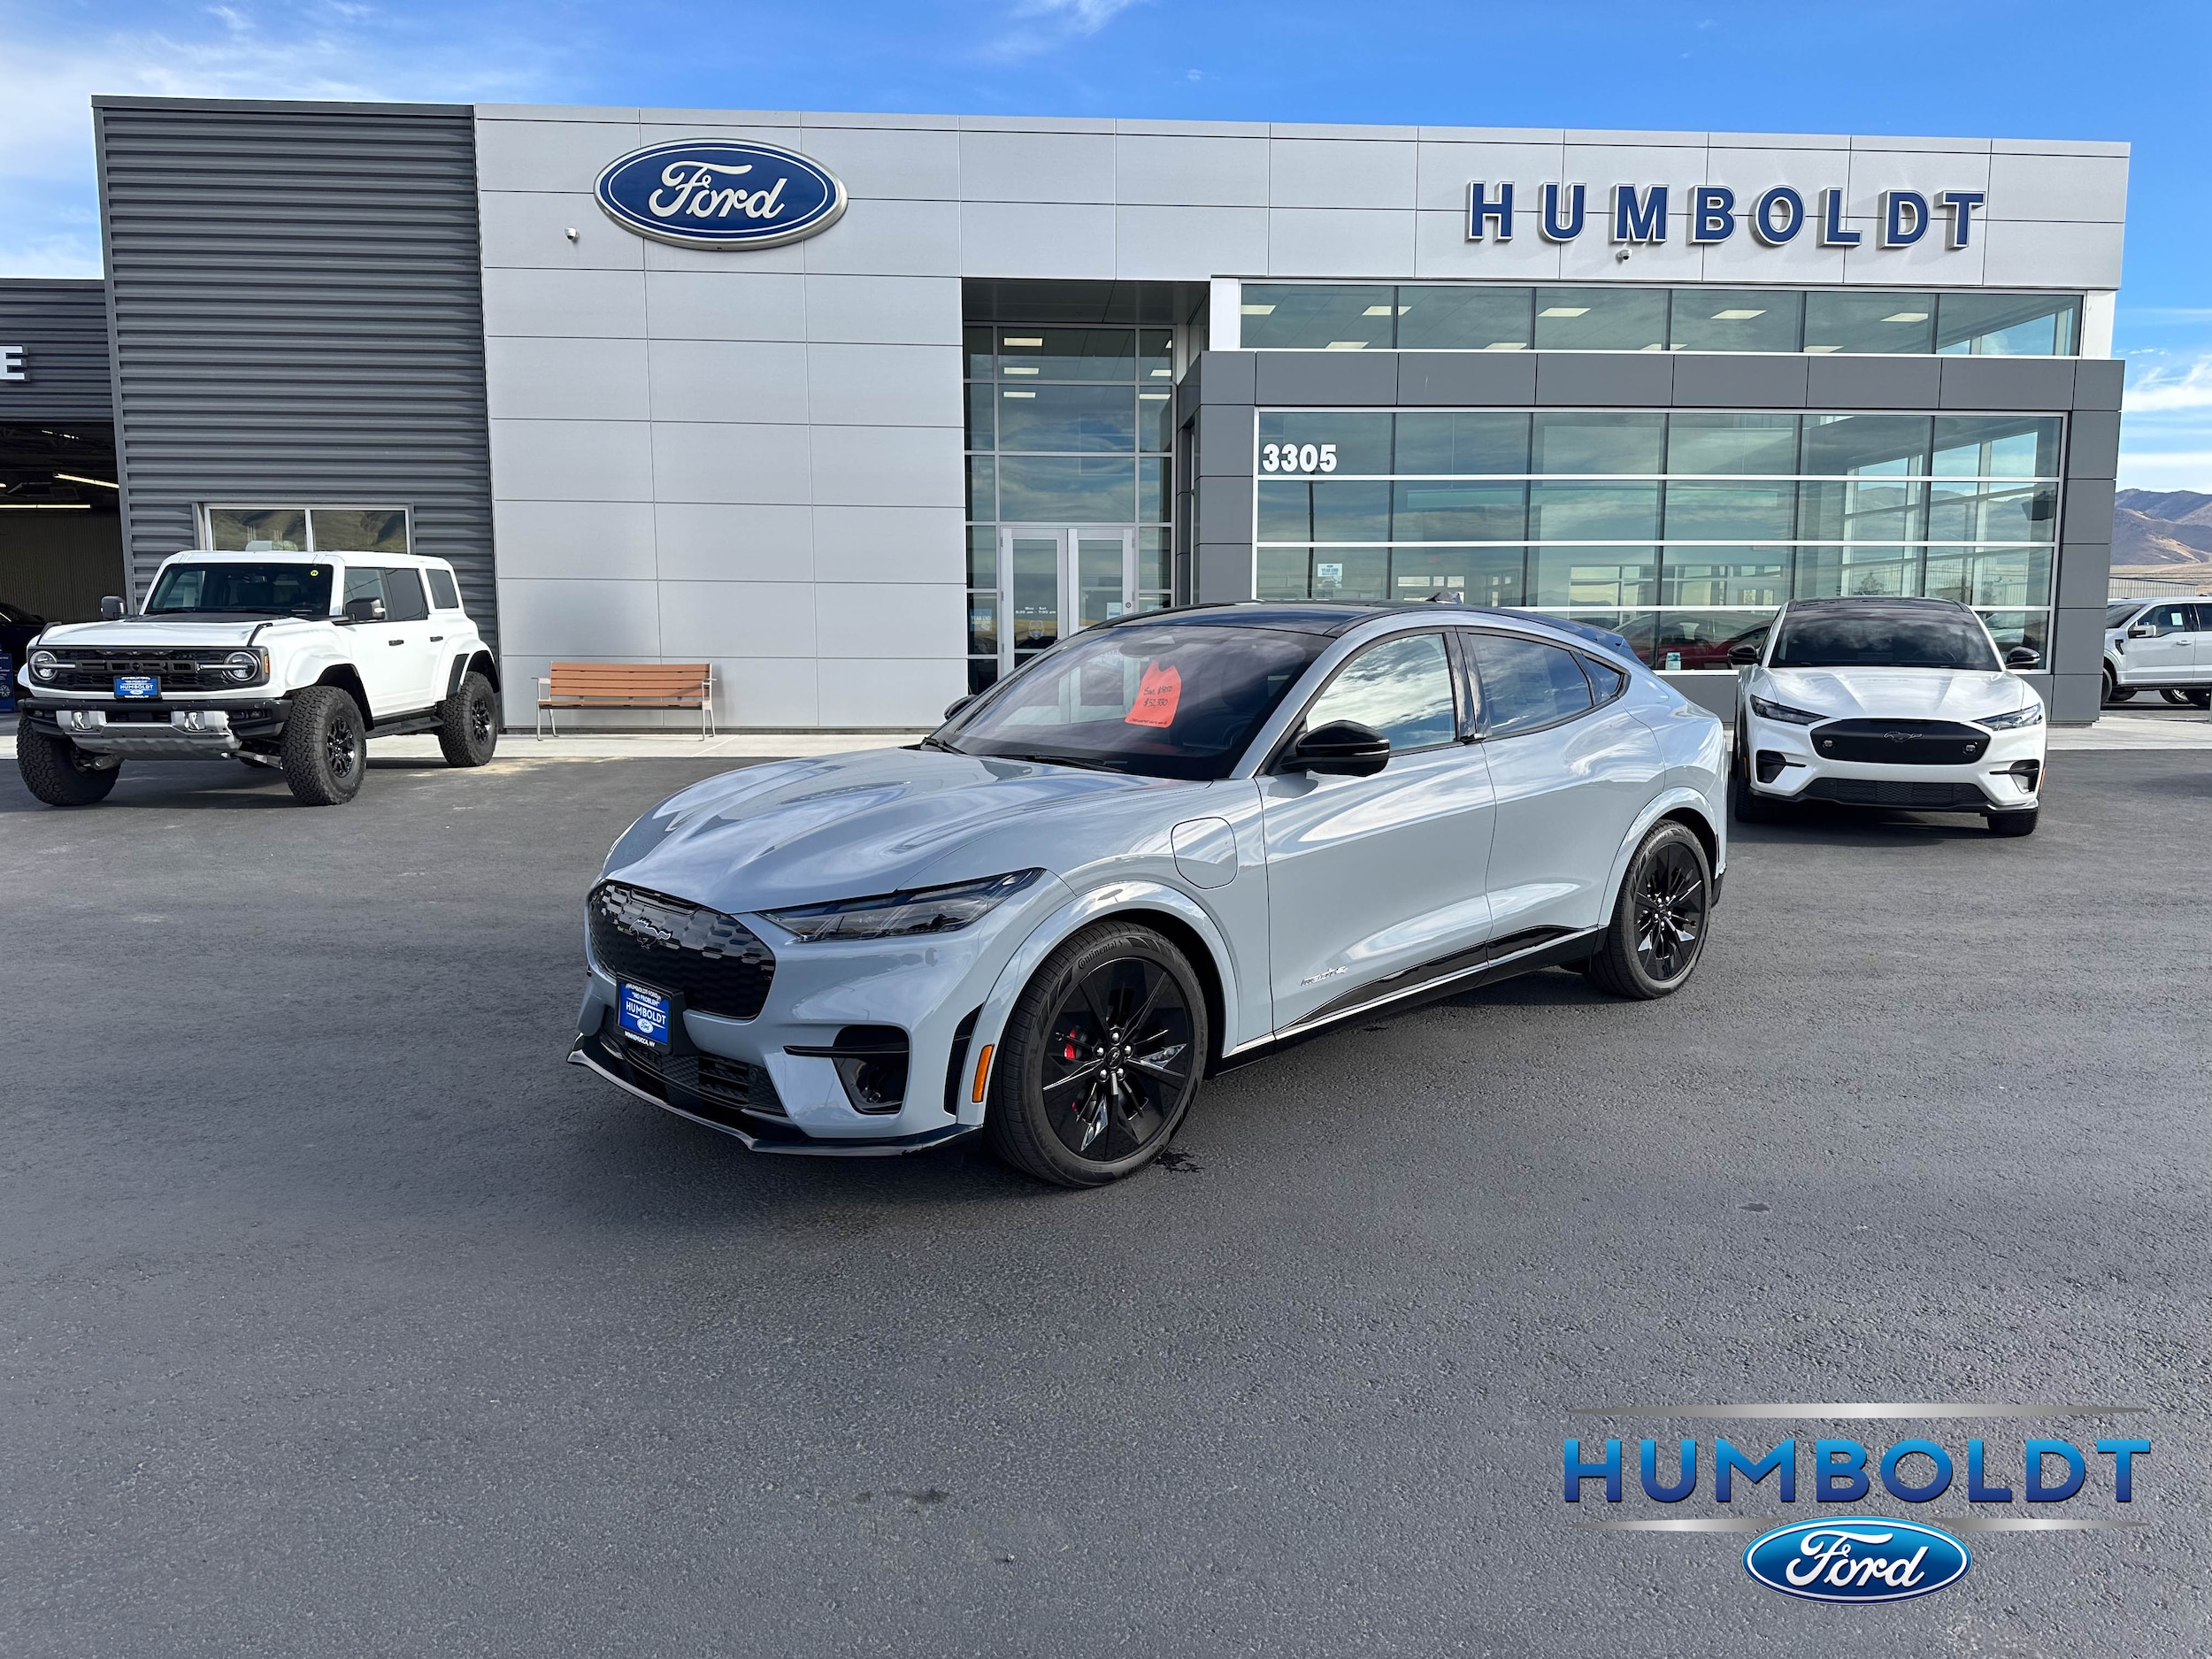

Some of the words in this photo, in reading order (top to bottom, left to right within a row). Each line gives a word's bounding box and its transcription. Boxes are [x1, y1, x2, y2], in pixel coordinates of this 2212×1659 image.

[649, 161, 787, 219] Ford
[1466, 180, 1985, 249] HUMBOLDT
[1263, 443, 1337, 472] 3305
[626, 1001, 666, 1025] HUMBOLDT
